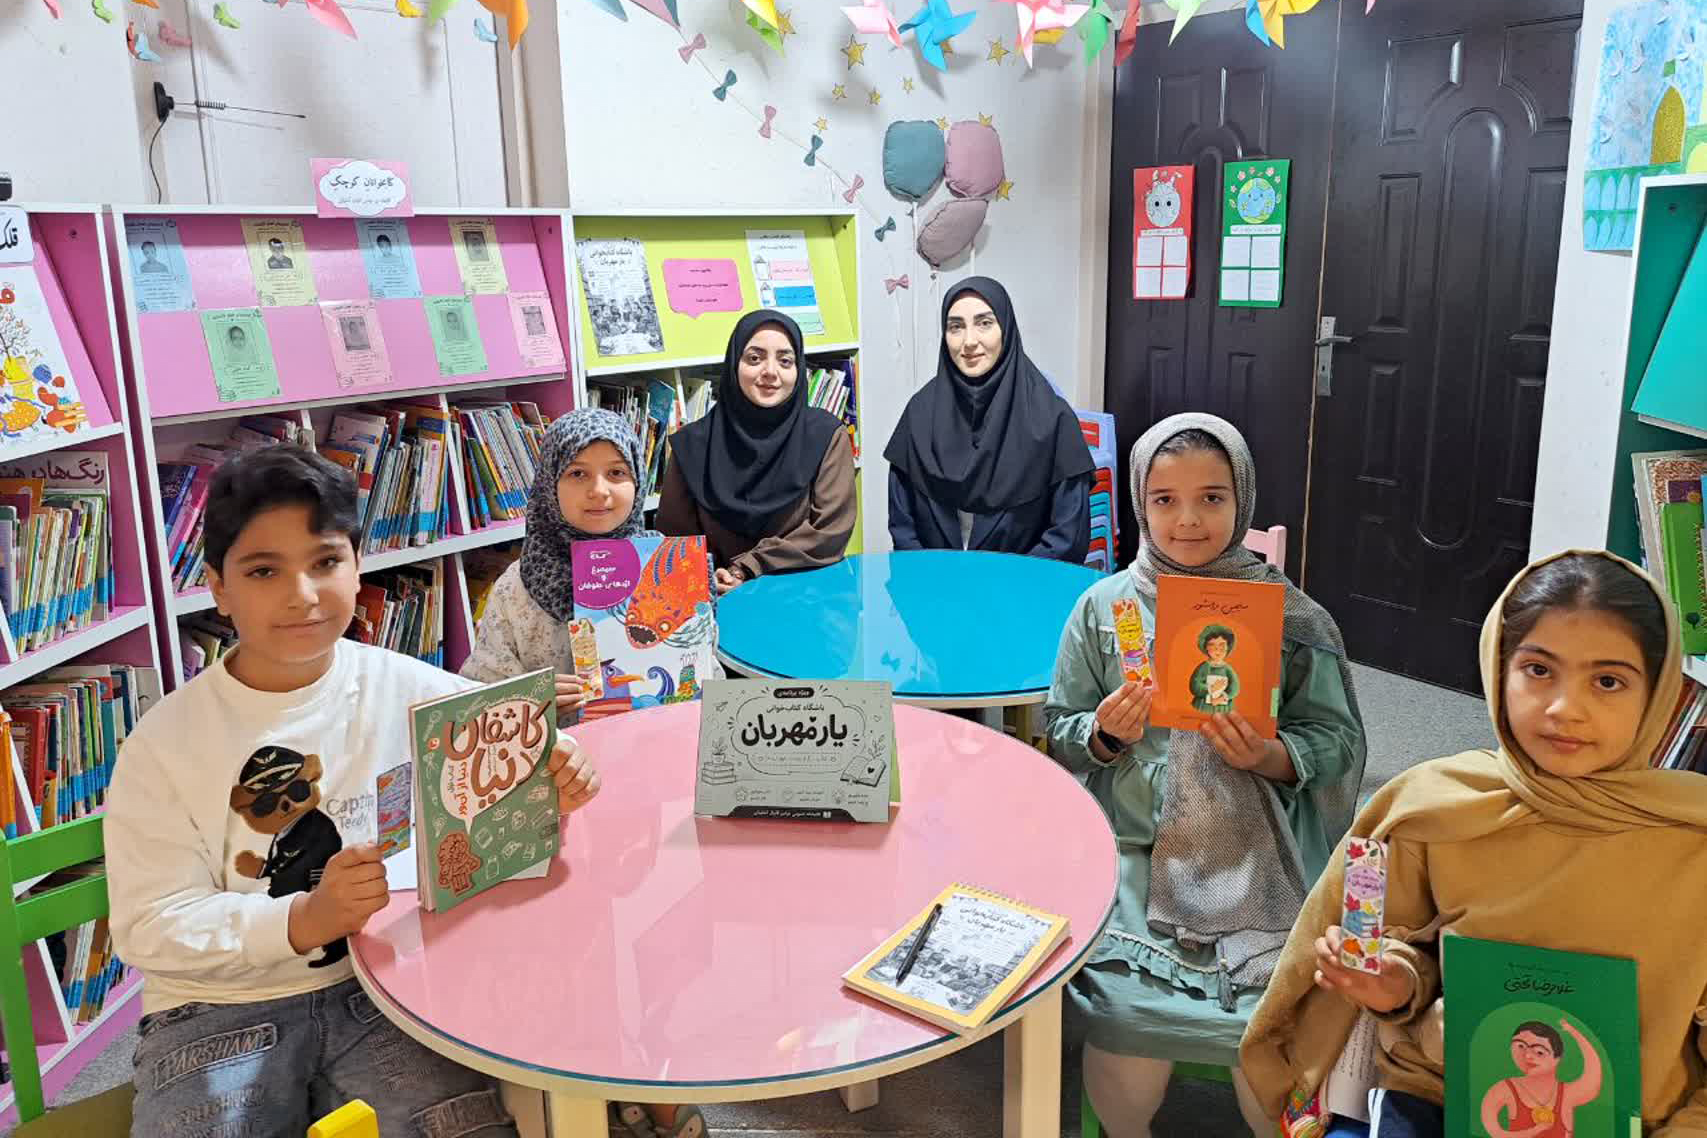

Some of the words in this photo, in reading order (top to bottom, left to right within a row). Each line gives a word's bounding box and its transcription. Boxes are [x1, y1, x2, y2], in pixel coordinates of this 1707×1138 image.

[803, 702, 825, 712] باشگاه
[443, 700, 552, 761] کاشفان
[741, 713, 818, 747] مهربان
[815, 713, 848, 747] یار
[470, 747, 536, 810] دنیا
